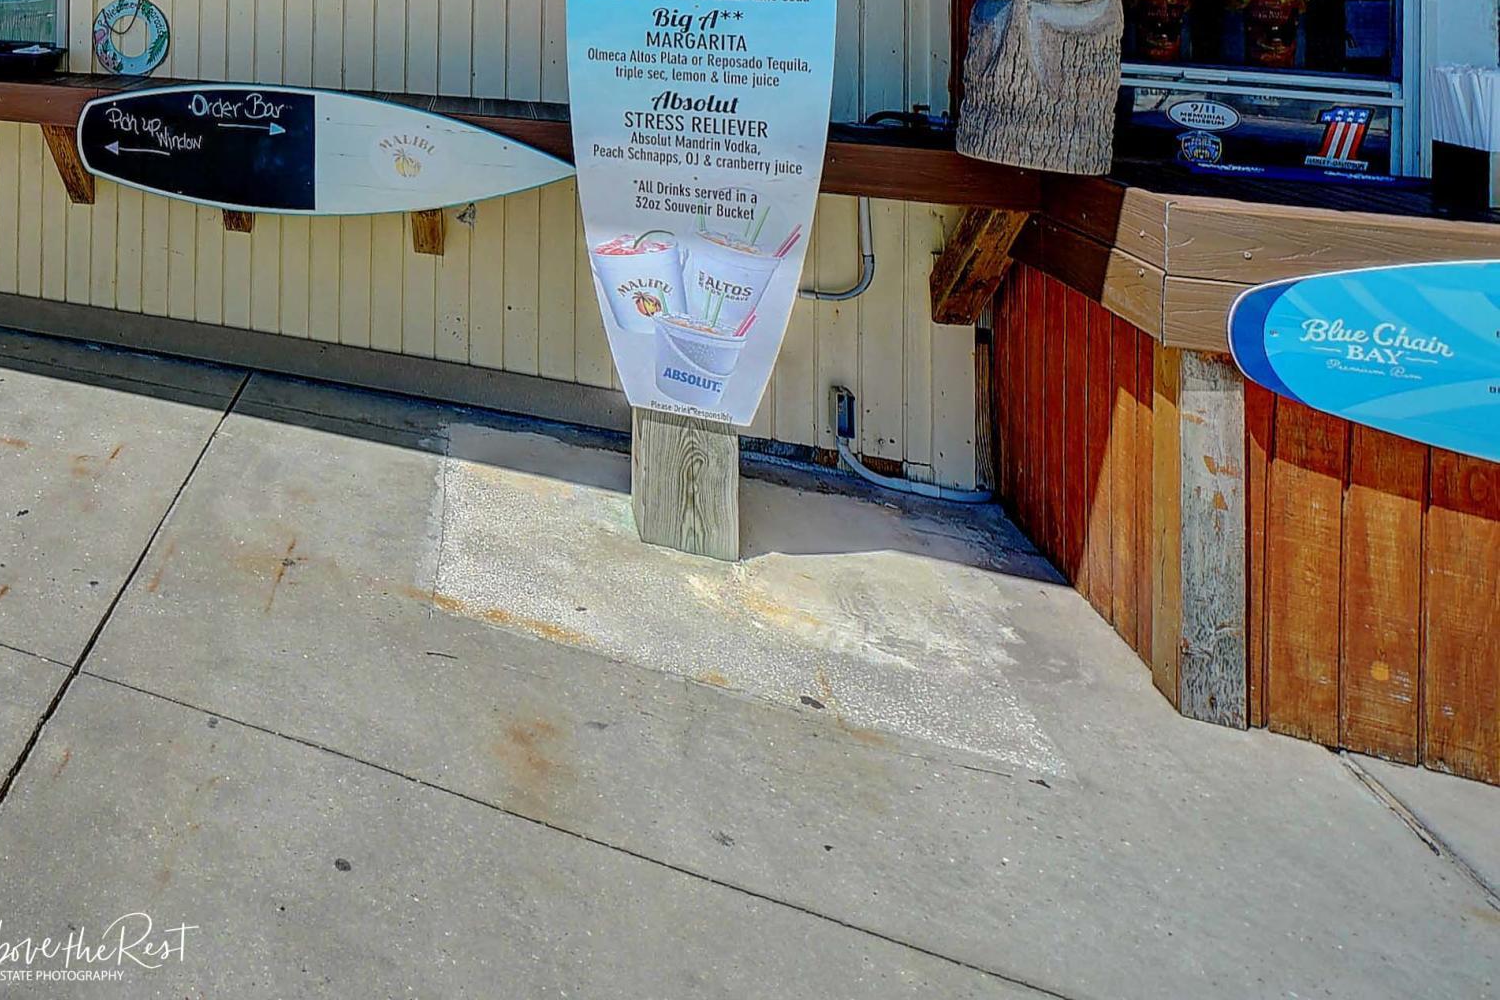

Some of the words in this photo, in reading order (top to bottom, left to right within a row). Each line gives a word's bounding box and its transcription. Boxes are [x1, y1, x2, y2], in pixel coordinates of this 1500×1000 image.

[653, 7, 693, 33] Big
[646, 32, 747, 52] MARGARITA
[192, 94, 241, 119] Order
[245, 93, 284, 119] Bar
[651, 90, 739, 114] Absolut
[142, 118, 161, 136] up
[625, 111, 684, 131] STRESS
[692, 117, 768, 138] RELIEVER
[157, 127, 203, 149] Window
[379, 134, 438, 156] MALIBU
[593, 144, 623, 160] Peach
[628, 147, 681, 166] Schnapps,
[686, 152, 699, 166] OJ
[704, 154, 711, 167] &
[716, 157, 770, 174] cranberry
[774, 160, 802, 176] juice
[657, 181, 691, 197] Drinks
[695, 185, 731, 202] served
[736, 190, 746, 202] in
[751, 194, 757, 204] a
[635, 196, 660, 211] 32oz
[665, 199, 711, 216] Souvenir
[716, 204, 754, 221] Bucket
[705, 276, 753, 296] ALTOS
[1300, 319, 1369, 343] Blue
[1373, 322, 1454, 357] Chair
[1347, 345, 1403, 365] BAY
